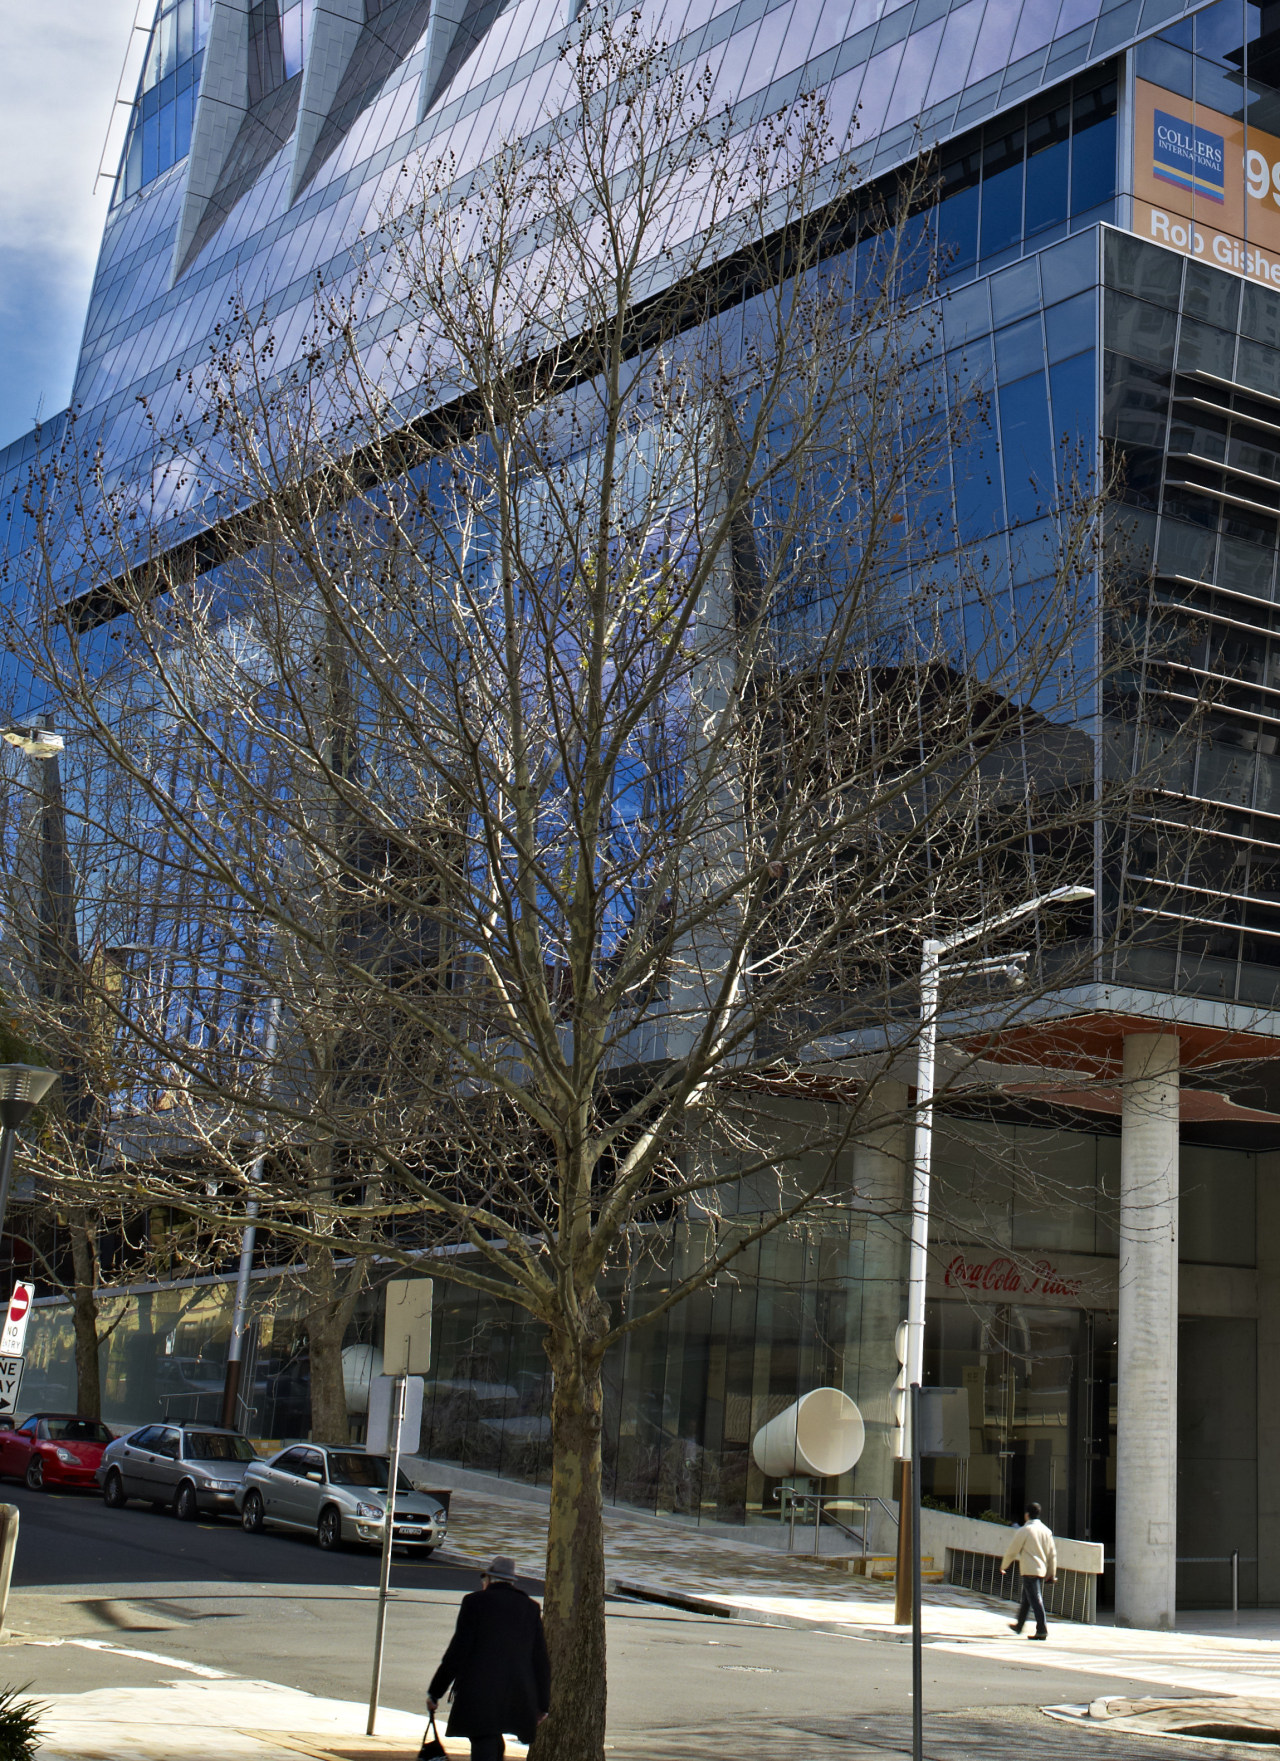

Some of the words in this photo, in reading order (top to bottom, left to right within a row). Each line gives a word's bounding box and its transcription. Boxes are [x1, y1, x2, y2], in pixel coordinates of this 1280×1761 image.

[1157, 125, 1222, 163] COLLIERS
[1158, 139, 1222, 172] INTERNATIONAL
[1151, 208, 1204, 254] Rob
[944, 1255, 1021, 1292] Coca-Cola
[1024, 1259, 1083, 1296] Place
[8, 1326, 18, 1337] NO
[0, 1361, 17, 1376] NE
